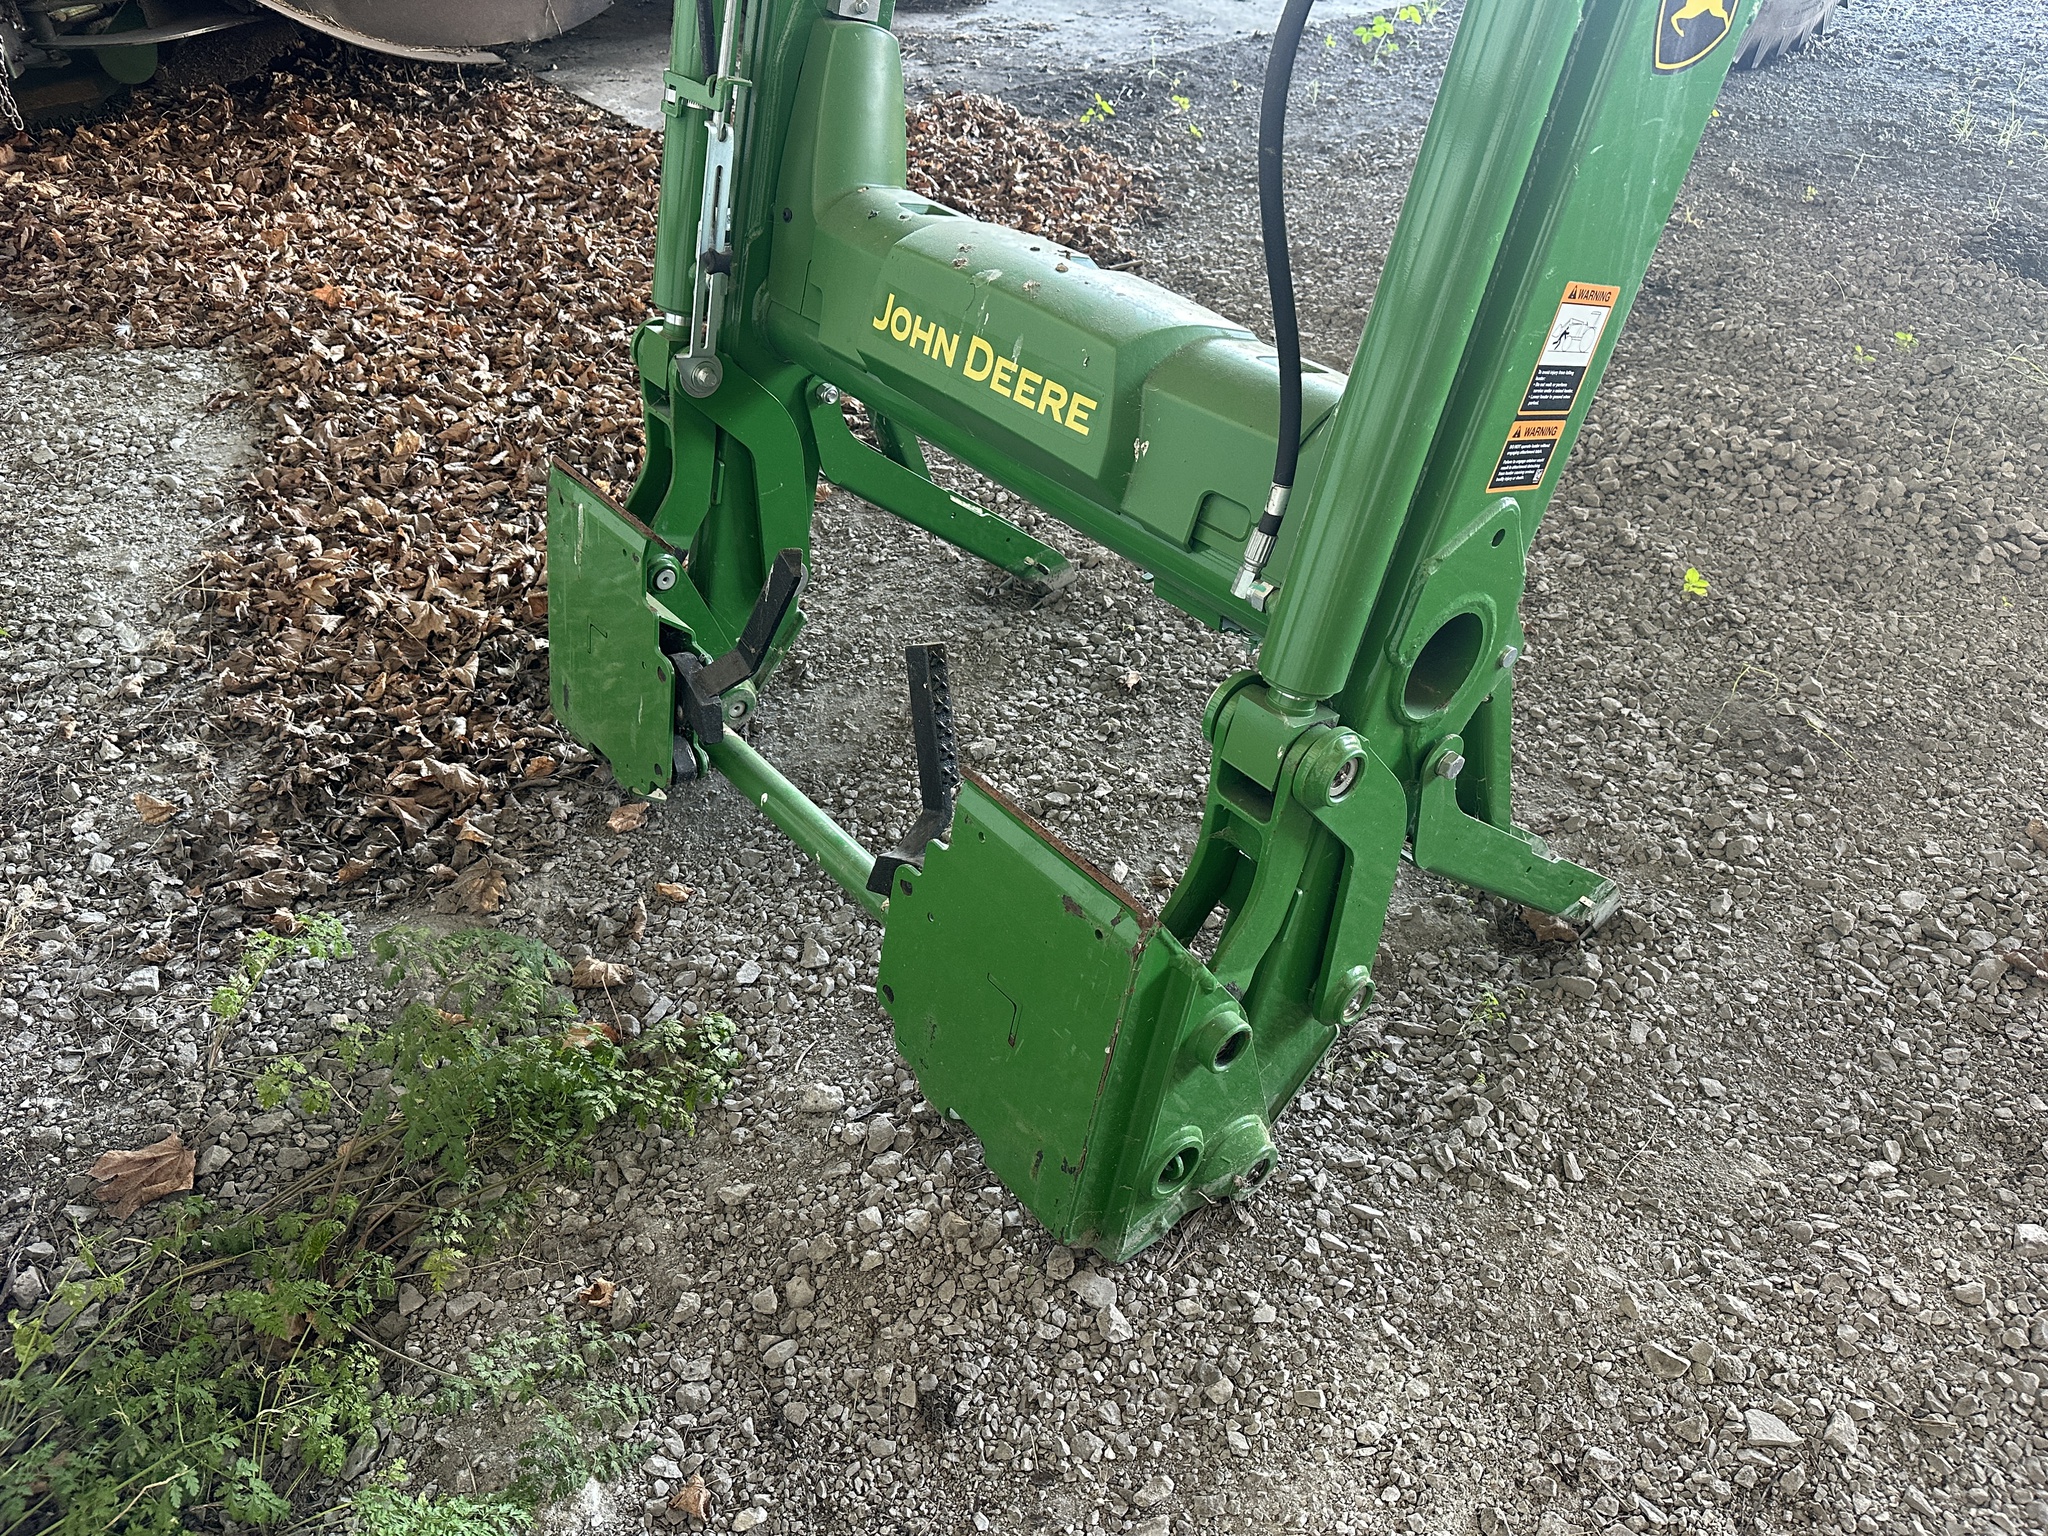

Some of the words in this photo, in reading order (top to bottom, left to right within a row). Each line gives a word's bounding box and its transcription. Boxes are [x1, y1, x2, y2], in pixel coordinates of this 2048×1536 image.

[1578, 289, 1612, 302] WARNING
[873, 293, 959, 368] JOHN
[963, 335, 1097, 436] DEERE
[1524, 426, 1558, 437] WARNING
